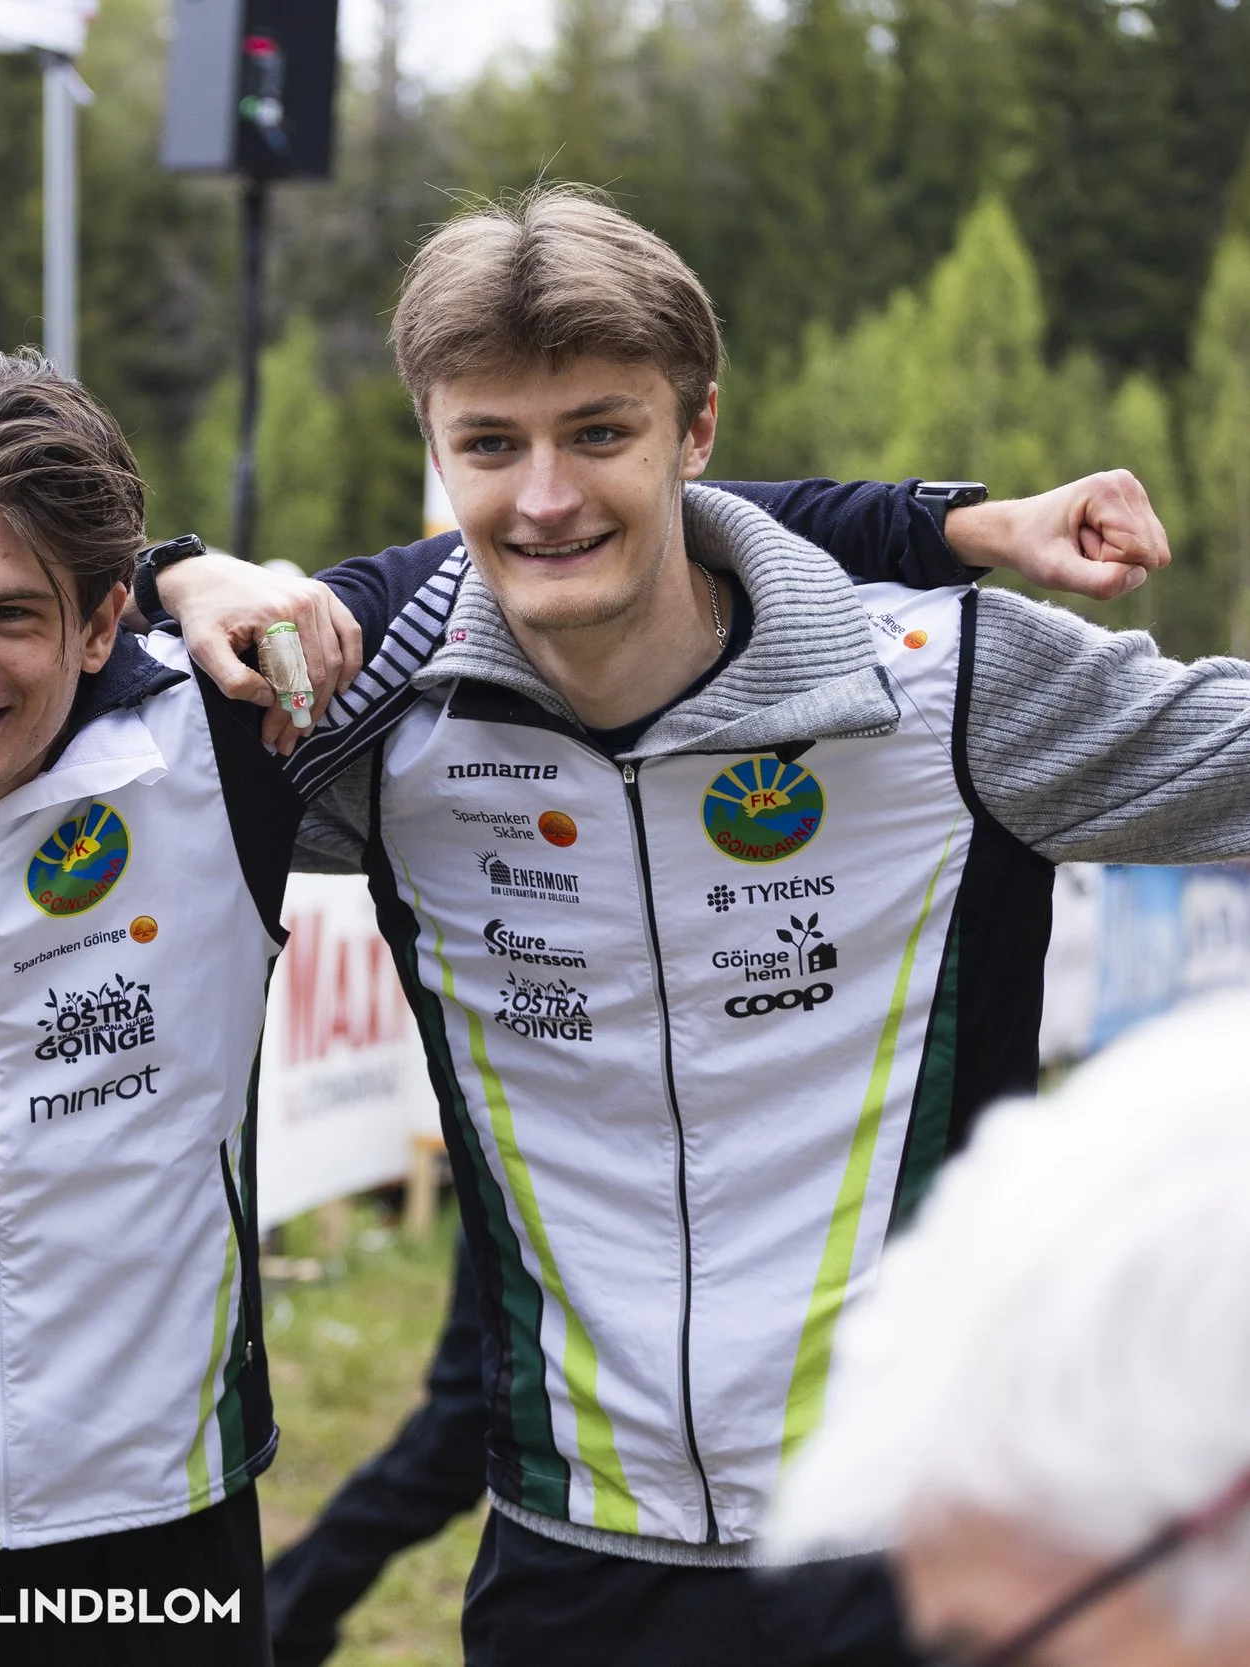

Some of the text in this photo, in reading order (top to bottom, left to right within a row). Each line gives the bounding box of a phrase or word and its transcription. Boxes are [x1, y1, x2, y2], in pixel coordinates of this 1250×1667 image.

[447, 762, 559, 780] noname
[750, 791, 778, 809] FK
[451, 808, 531, 825] Sparbanken
[492, 825, 536, 841] Skåne
[66, 839, 91, 863] FK
[512, 867, 579, 893] ENERMONT
[740, 875, 836, 905] TYRÉNS
[483, 919, 547, 956] Sture
[13, 928, 127, 974] Sparbanken Göinge
[711, 949, 790, 969] Göinge
[744, 966, 792, 983] hem
[512, 986, 590, 1019] ÖSTRA
[724, 982, 834, 1019] coop
[56, 993, 154, 1033] ÖSTRA
[92, 1023, 124, 1033] GRÖNA
